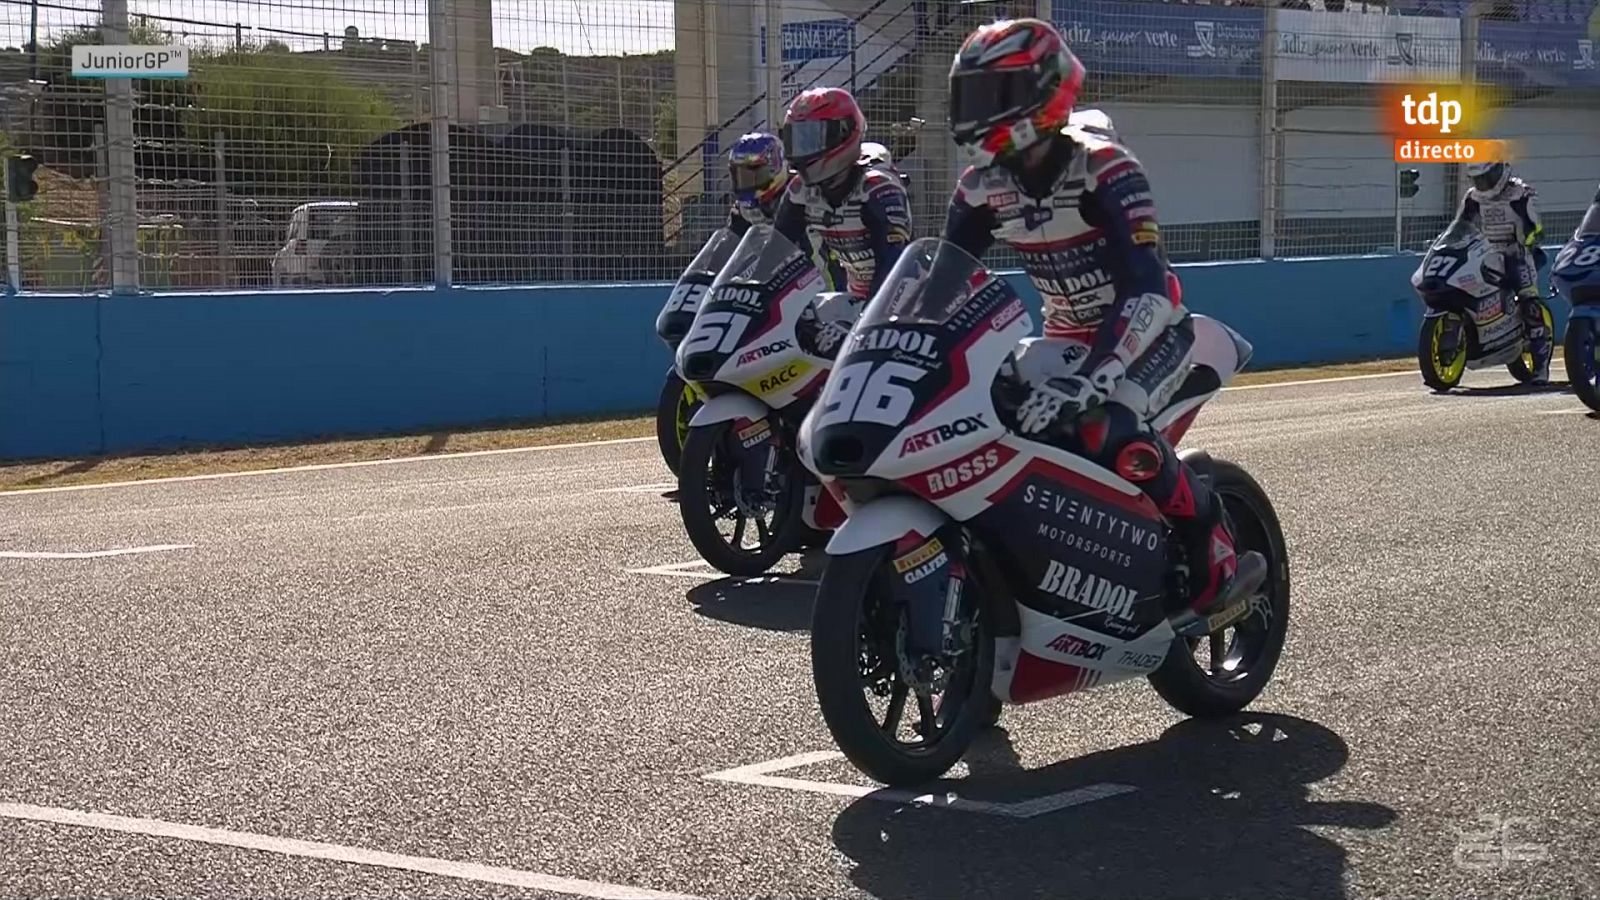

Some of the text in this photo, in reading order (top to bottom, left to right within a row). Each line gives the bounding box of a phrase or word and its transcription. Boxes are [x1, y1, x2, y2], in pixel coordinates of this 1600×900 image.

[1424, 255, 1458, 278] 27
[684, 311, 752, 358] 51
[736, 339, 794, 368] ARTBOX
[759, 365, 798, 393] RACC
[816, 360, 929, 431] 96
[898, 413, 989, 459] ARTBOX
[926, 449, 999, 494] ROSSS
[1023, 484, 1158, 551] SEVENTYTWO
[904, 551, 948, 584] GALFER
[1037, 523, 1131, 568] MOTORSPORTS
[1038, 559, 1139, 622] BRADOL
[1045, 633, 1112, 661] ARTBOX
